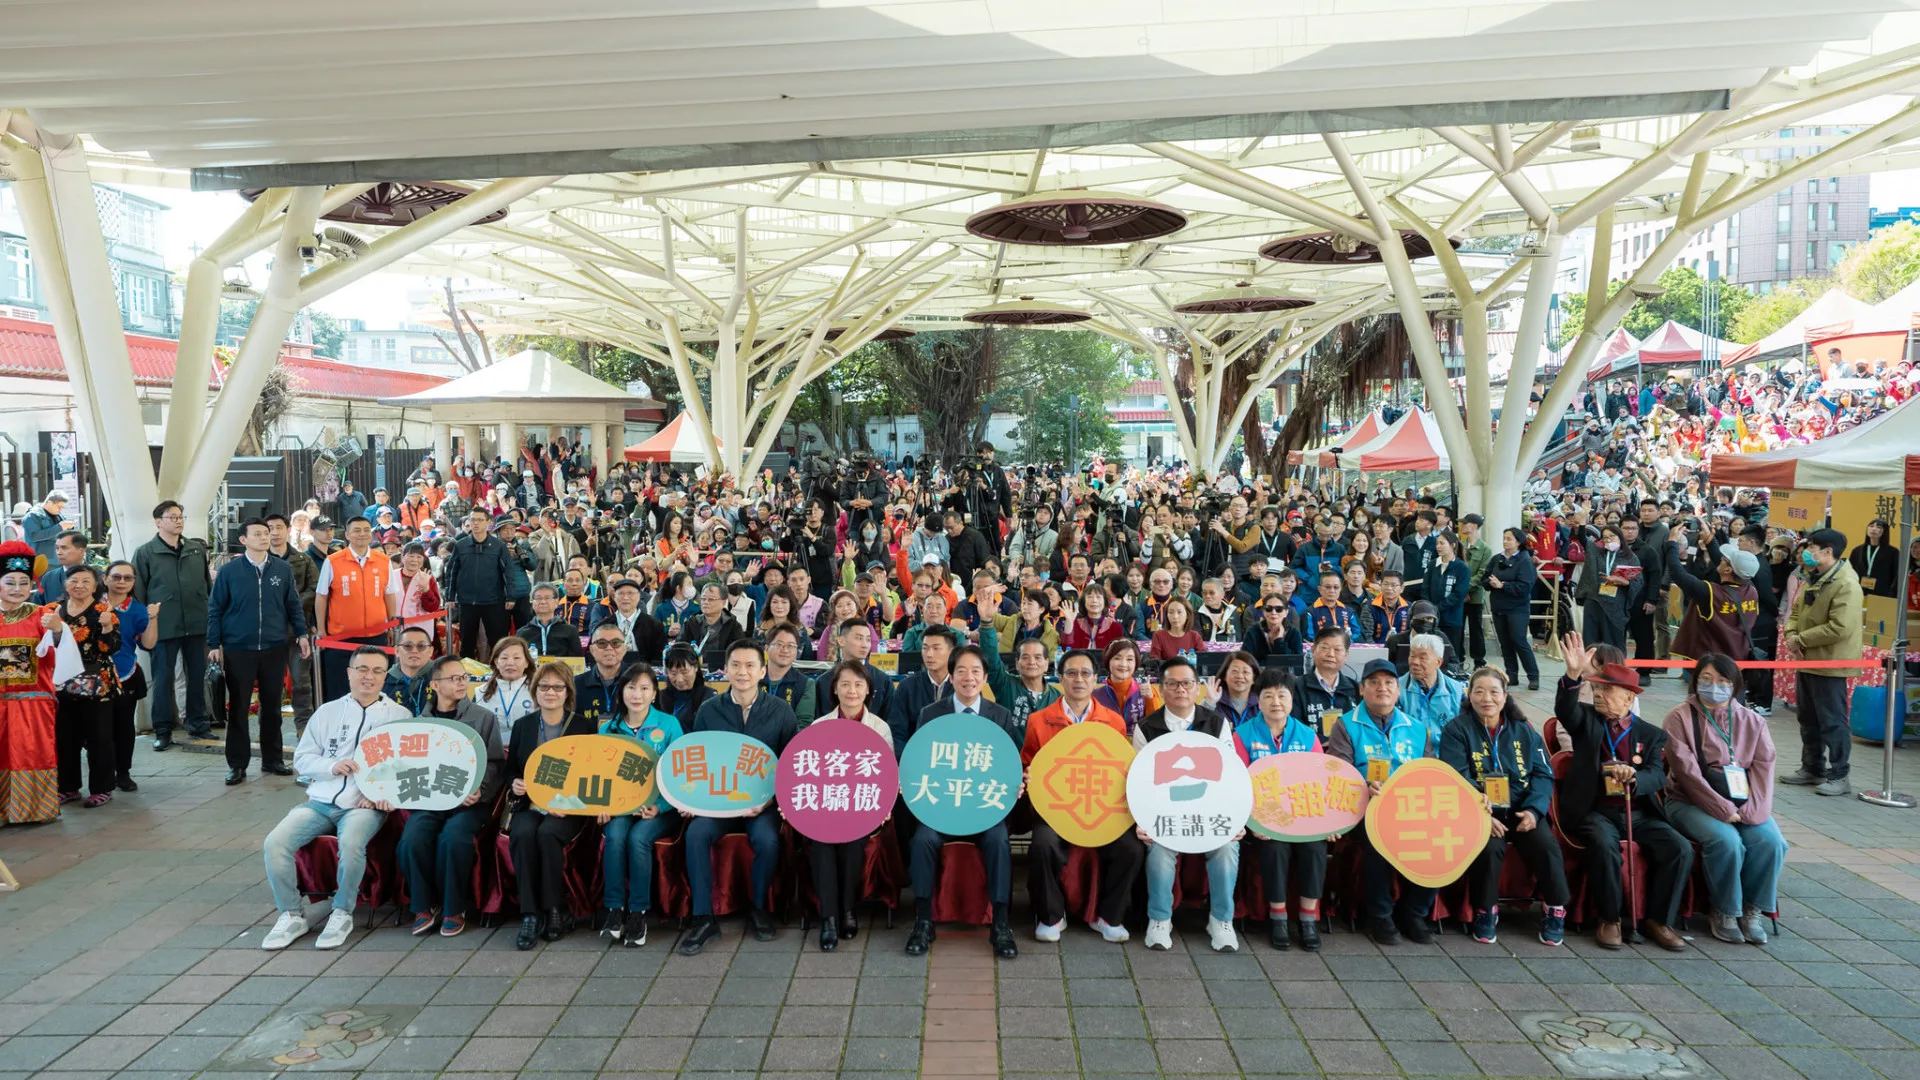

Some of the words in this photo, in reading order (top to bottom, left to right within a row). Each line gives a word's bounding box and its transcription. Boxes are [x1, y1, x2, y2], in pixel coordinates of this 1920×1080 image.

[360, 732, 429, 768] 歡迎
[792, 749, 882, 778] 我客家
[930, 740, 994, 773] 四海
[533, 750, 655, 806] 聽山歌
[671, 743, 771, 796] 唱山歌
[791, 783, 881, 812] 我驕傲
[910, 774, 1009, 810] 大平安
[1394, 785, 1460, 821] 正月
[1397, 826, 1464, 862] 二十
